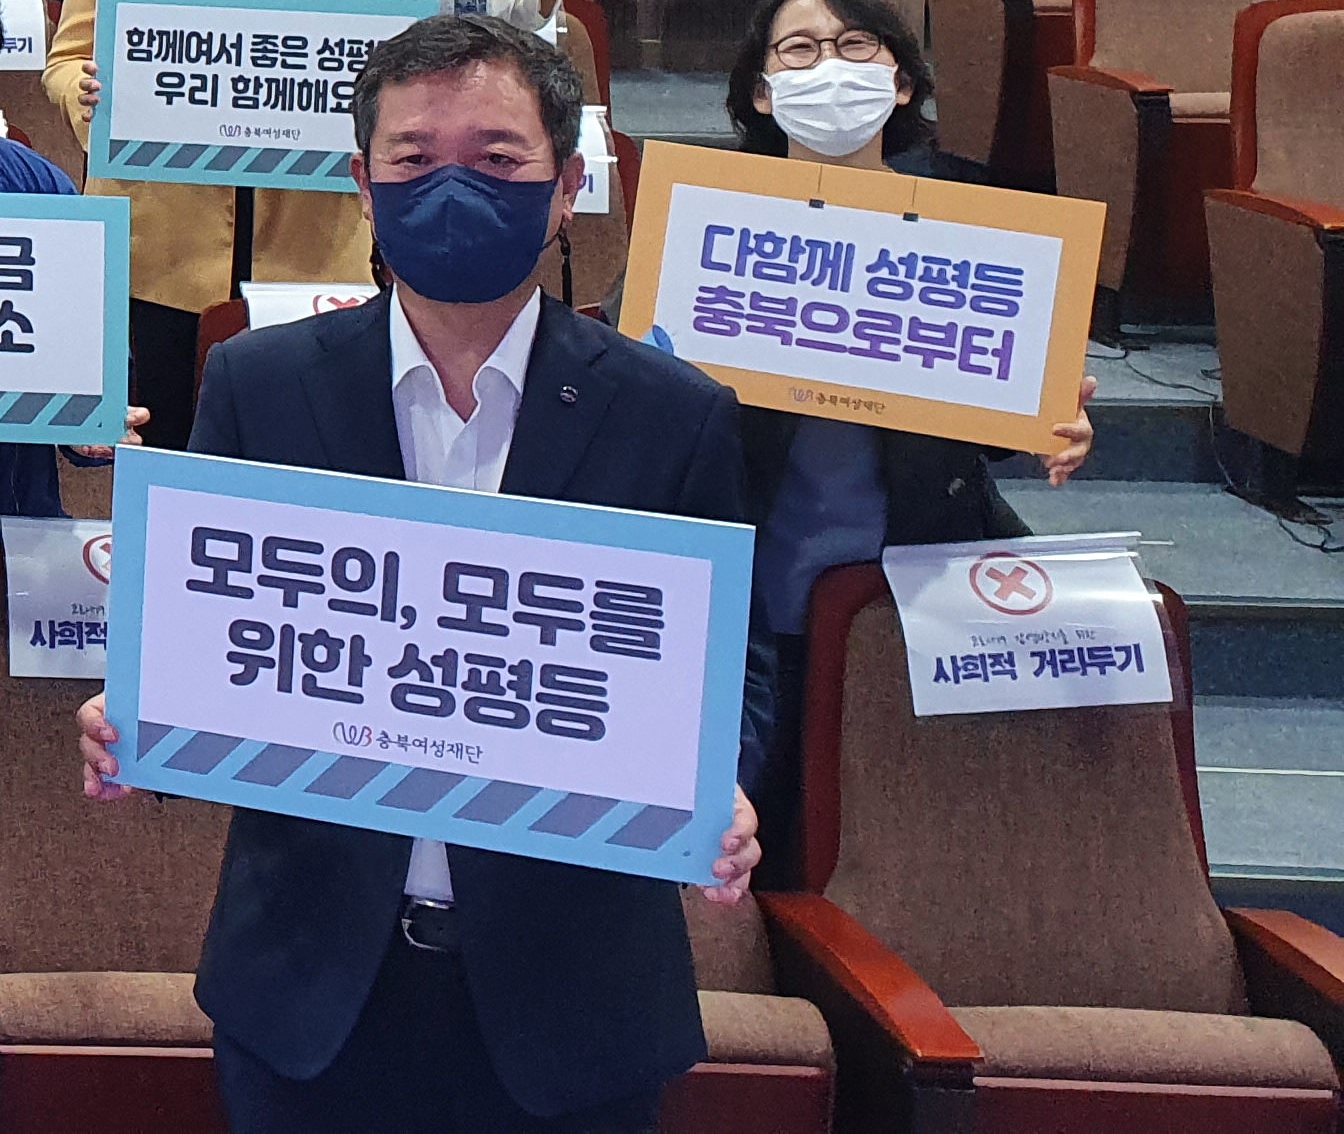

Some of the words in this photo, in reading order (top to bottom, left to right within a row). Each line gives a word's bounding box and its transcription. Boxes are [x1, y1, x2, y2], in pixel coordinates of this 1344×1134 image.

[126, 27, 242, 67] 함께여서
[249, 33, 309, 70] 좋은
[154, 72, 219, 108] 우리
[700, 223, 855, 293] 다함께
[865, 248, 1024, 318] 성평등
[692, 284, 1015, 382] 충북으로부터
[185, 525, 416, 631] 모두의,
[436, 561, 663, 661] 모두를
[30, 620, 107, 650] 사회적
[226, 618, 373, 706] 위한
[388, 642, 610, 742] 성평등
[933, 651, 1018, 684] 사회적
[1030, 643, 1144, 678] 거리두기
[376, 730, 484, 766] 충북여성재단
